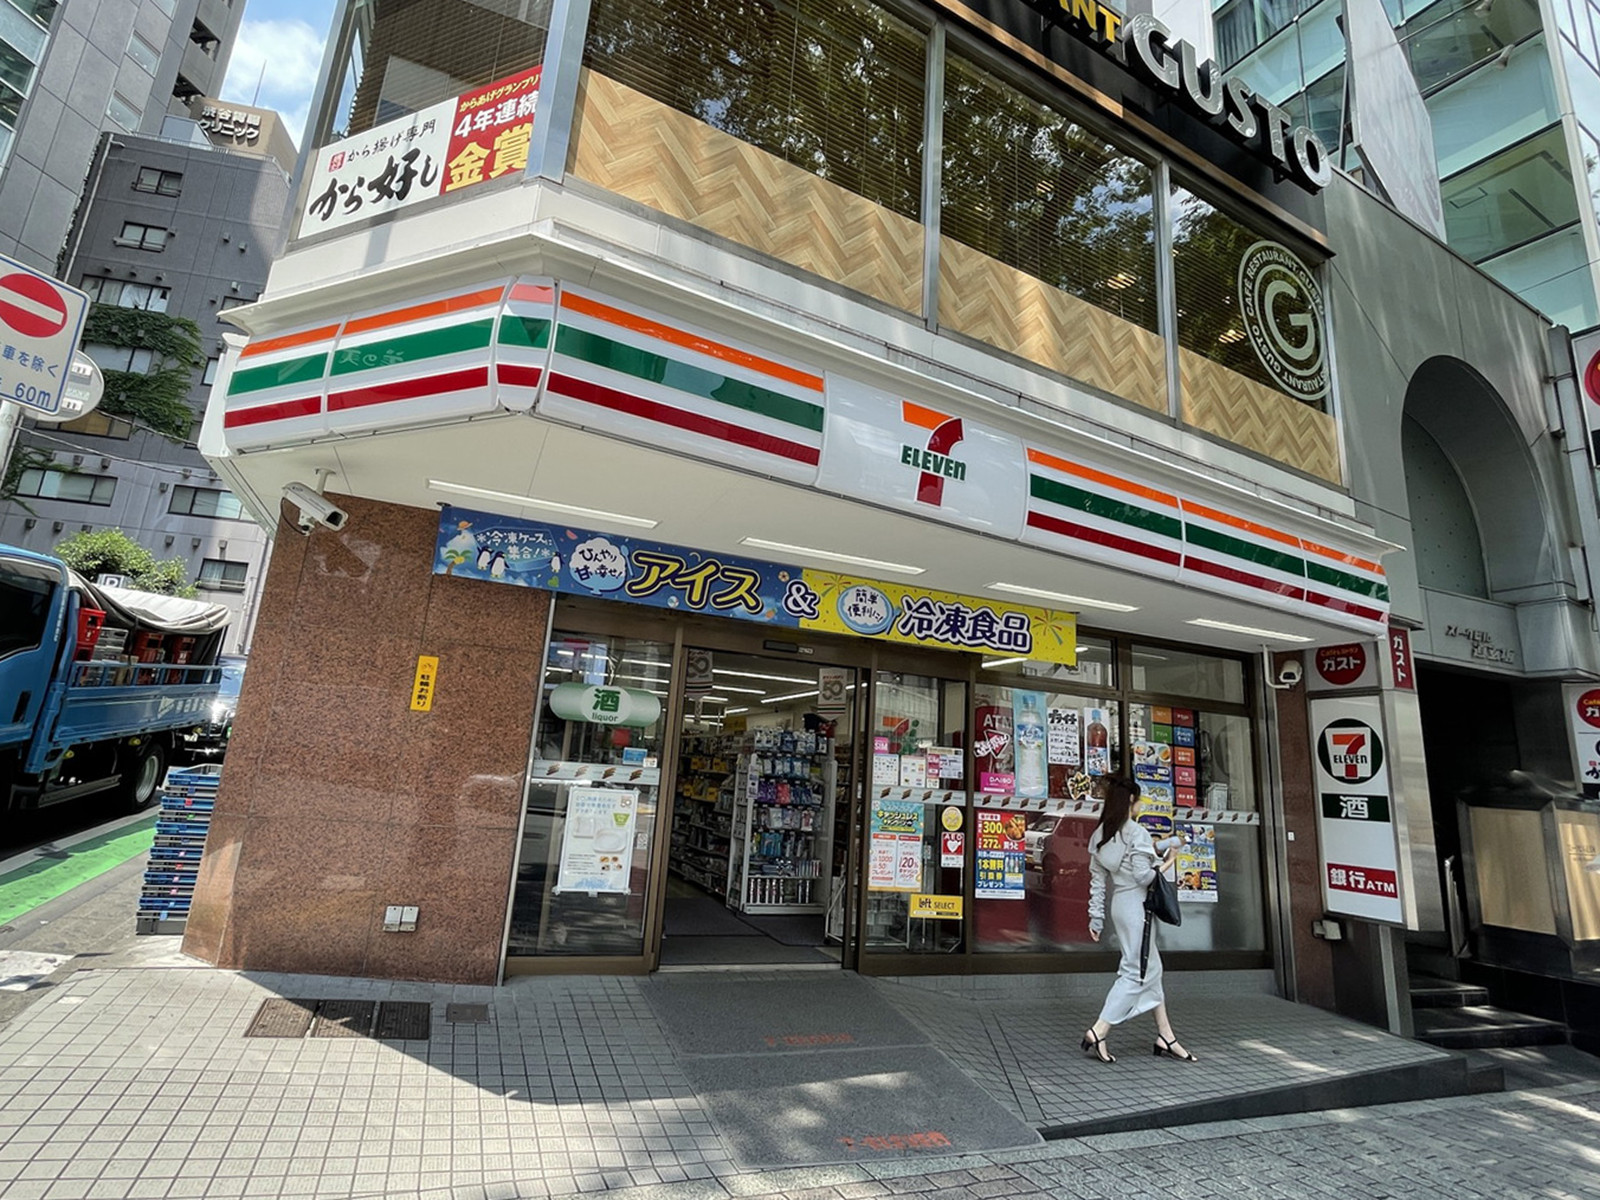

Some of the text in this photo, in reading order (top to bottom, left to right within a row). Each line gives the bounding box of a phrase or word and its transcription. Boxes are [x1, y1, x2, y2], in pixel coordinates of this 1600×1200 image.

[1123, 13, 1331, 194] GUSTO
[445, 122, 534, 192] 金賞
[309, 147, 439, 221] から好し
[1252, 325, 1281, 373] GUSTO
[15, 382, 51, 408] 60m
[487, 530, 552, 546] 冷凍ケースに
[578, 547, 618, 563] ひんやり
[626, 550, 820, 620] アイス &
[855, 588, 879, 605] 簡単
[897, 594, 1033, 654] 冷凍食品
[1322, 656, 1361, 671] ガスト
[1393, 635, 1407, 682] ガスト
[592, 688, 621, 713] 酒
[592, 712, 619, 722] liquor
[1332, 734, 1366, 778] 7
[1339, 795, 1369, 819] 酒
[934, 902, 955, 910] SELECT
